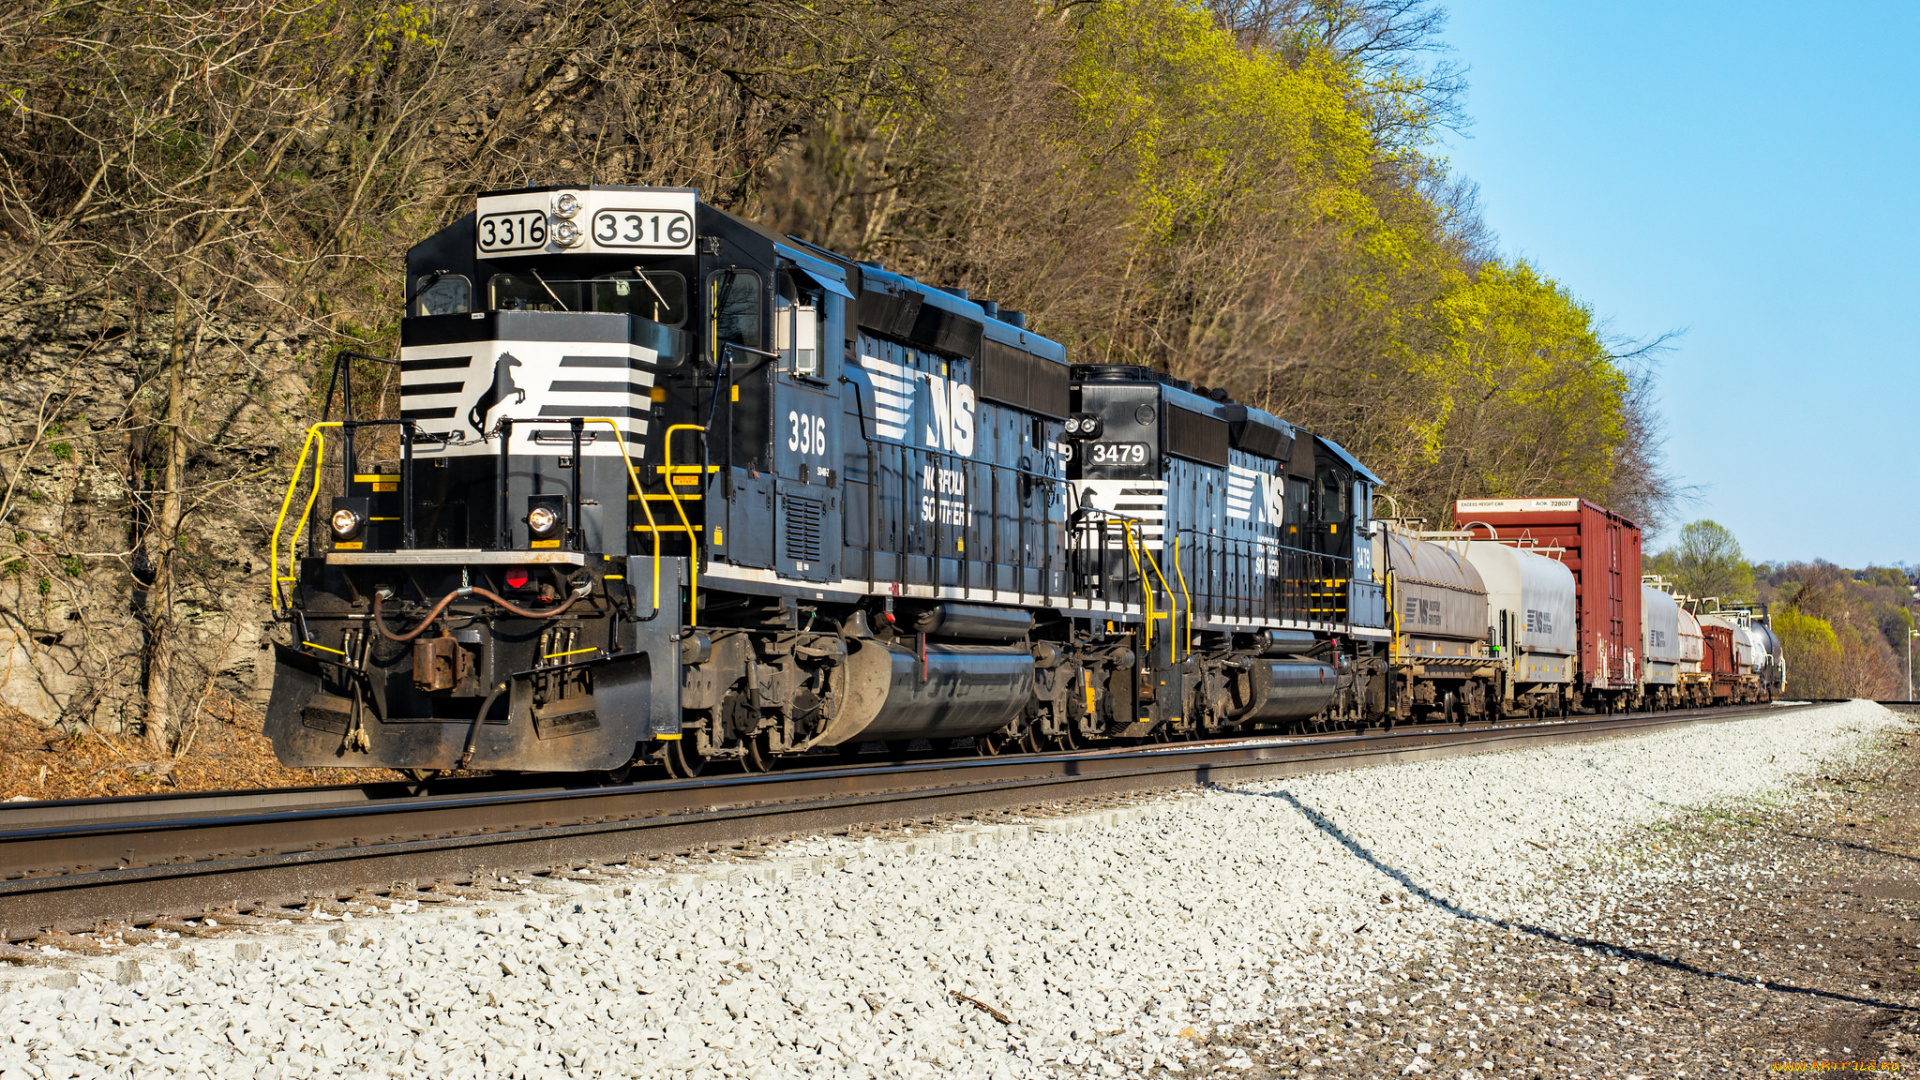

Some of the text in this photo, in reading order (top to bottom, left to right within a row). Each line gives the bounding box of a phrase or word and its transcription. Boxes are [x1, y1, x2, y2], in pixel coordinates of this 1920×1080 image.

[482, 217, 545, 247] 3316
[597, 214, 689, 243] 3316
[925, 372, 975, 457] NS
[788, 410, 826, 456] 3316
[1093, 444, 1145, 462] 3479
[921, 495, 972, 527] SOTHER
[1357, 546, 1370, 570] 3479
